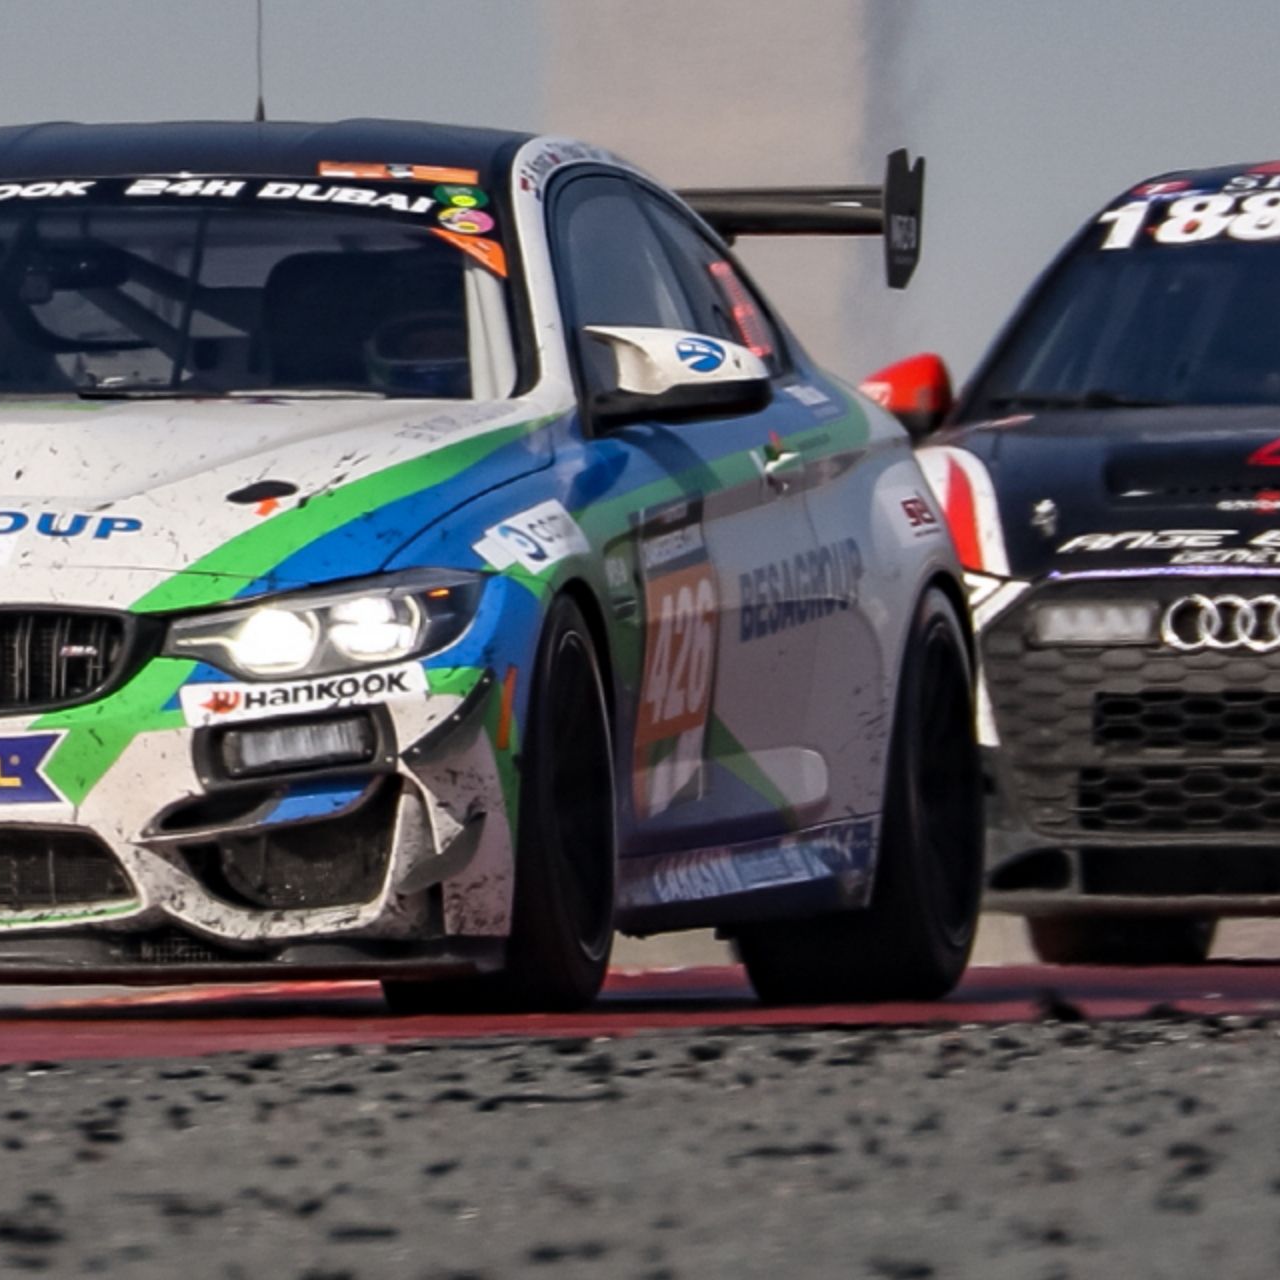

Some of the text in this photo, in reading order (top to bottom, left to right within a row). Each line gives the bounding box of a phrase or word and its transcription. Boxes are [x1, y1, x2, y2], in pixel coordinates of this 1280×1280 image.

[124, 179, 248, 197] 24H
[256, 181, 437, 214] DUBAI
[244, 671, 411, 711] HANKOOK
